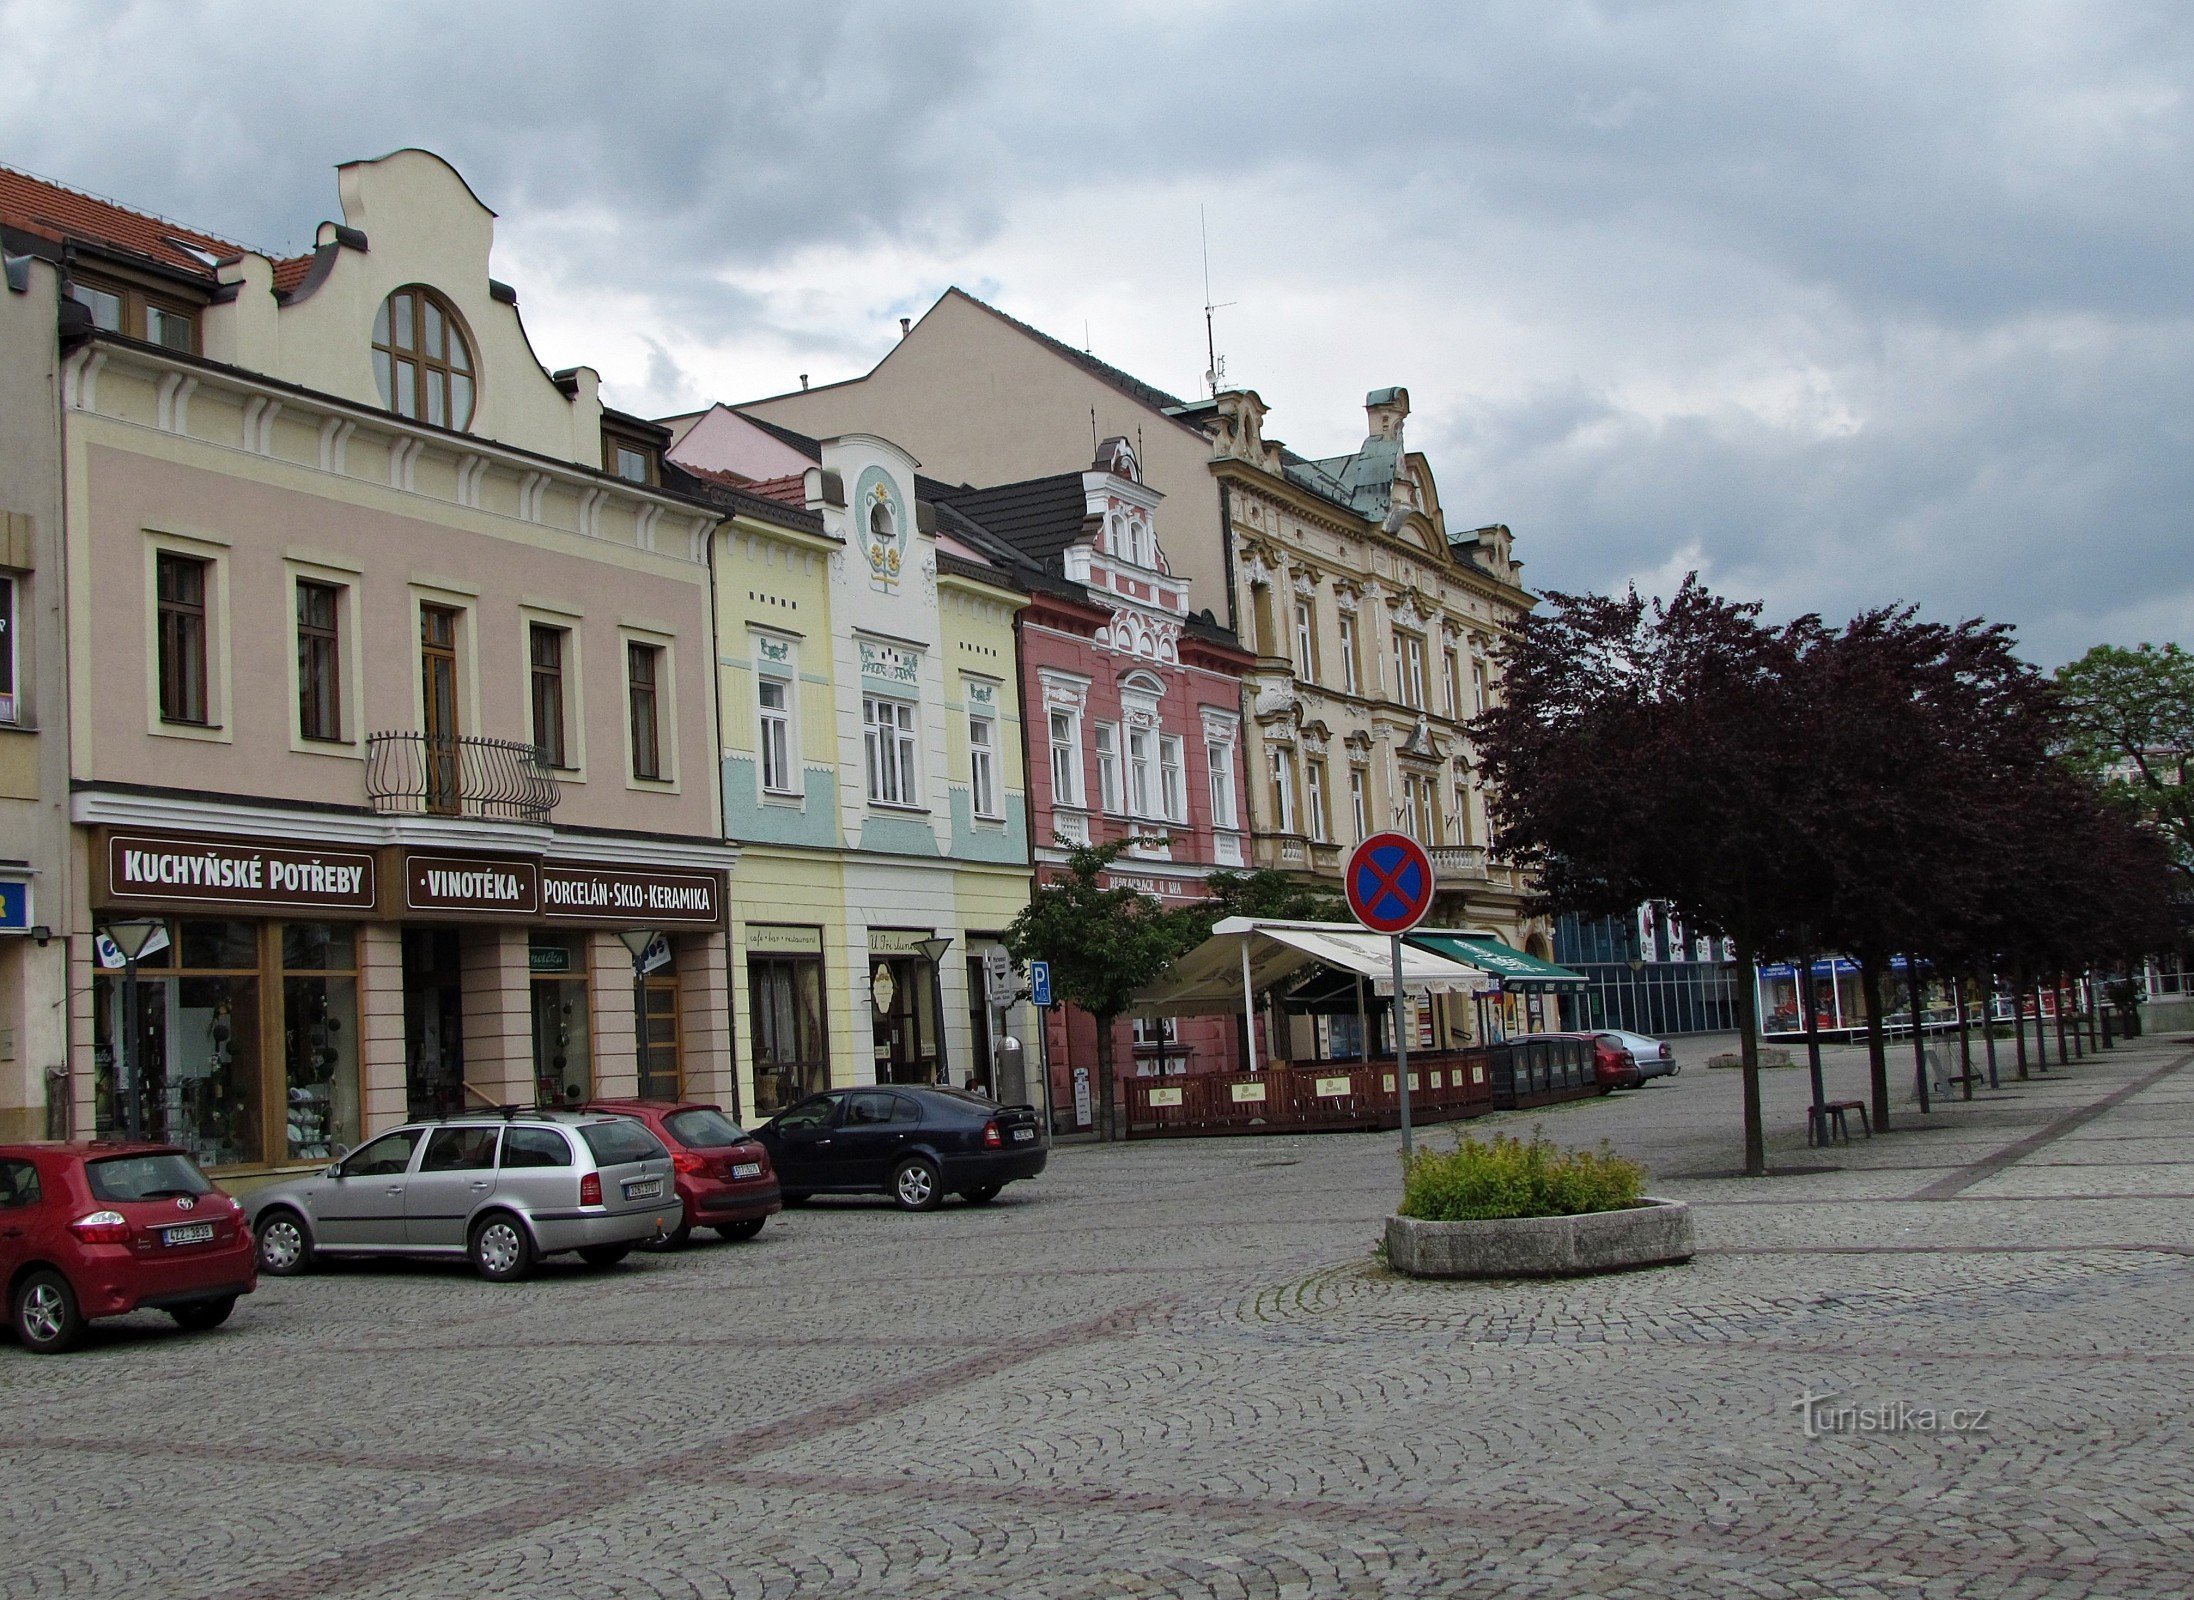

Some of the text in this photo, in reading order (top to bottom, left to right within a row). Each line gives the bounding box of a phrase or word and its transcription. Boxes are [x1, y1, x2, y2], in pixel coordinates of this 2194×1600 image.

[125, 850, 363, 894] KUCHYŇSKÉ POTŘEBY
[544, 878, 710, 911] PORCELÁN SKLO KERAMIKA
[1034, 967, 1045, 991] P
